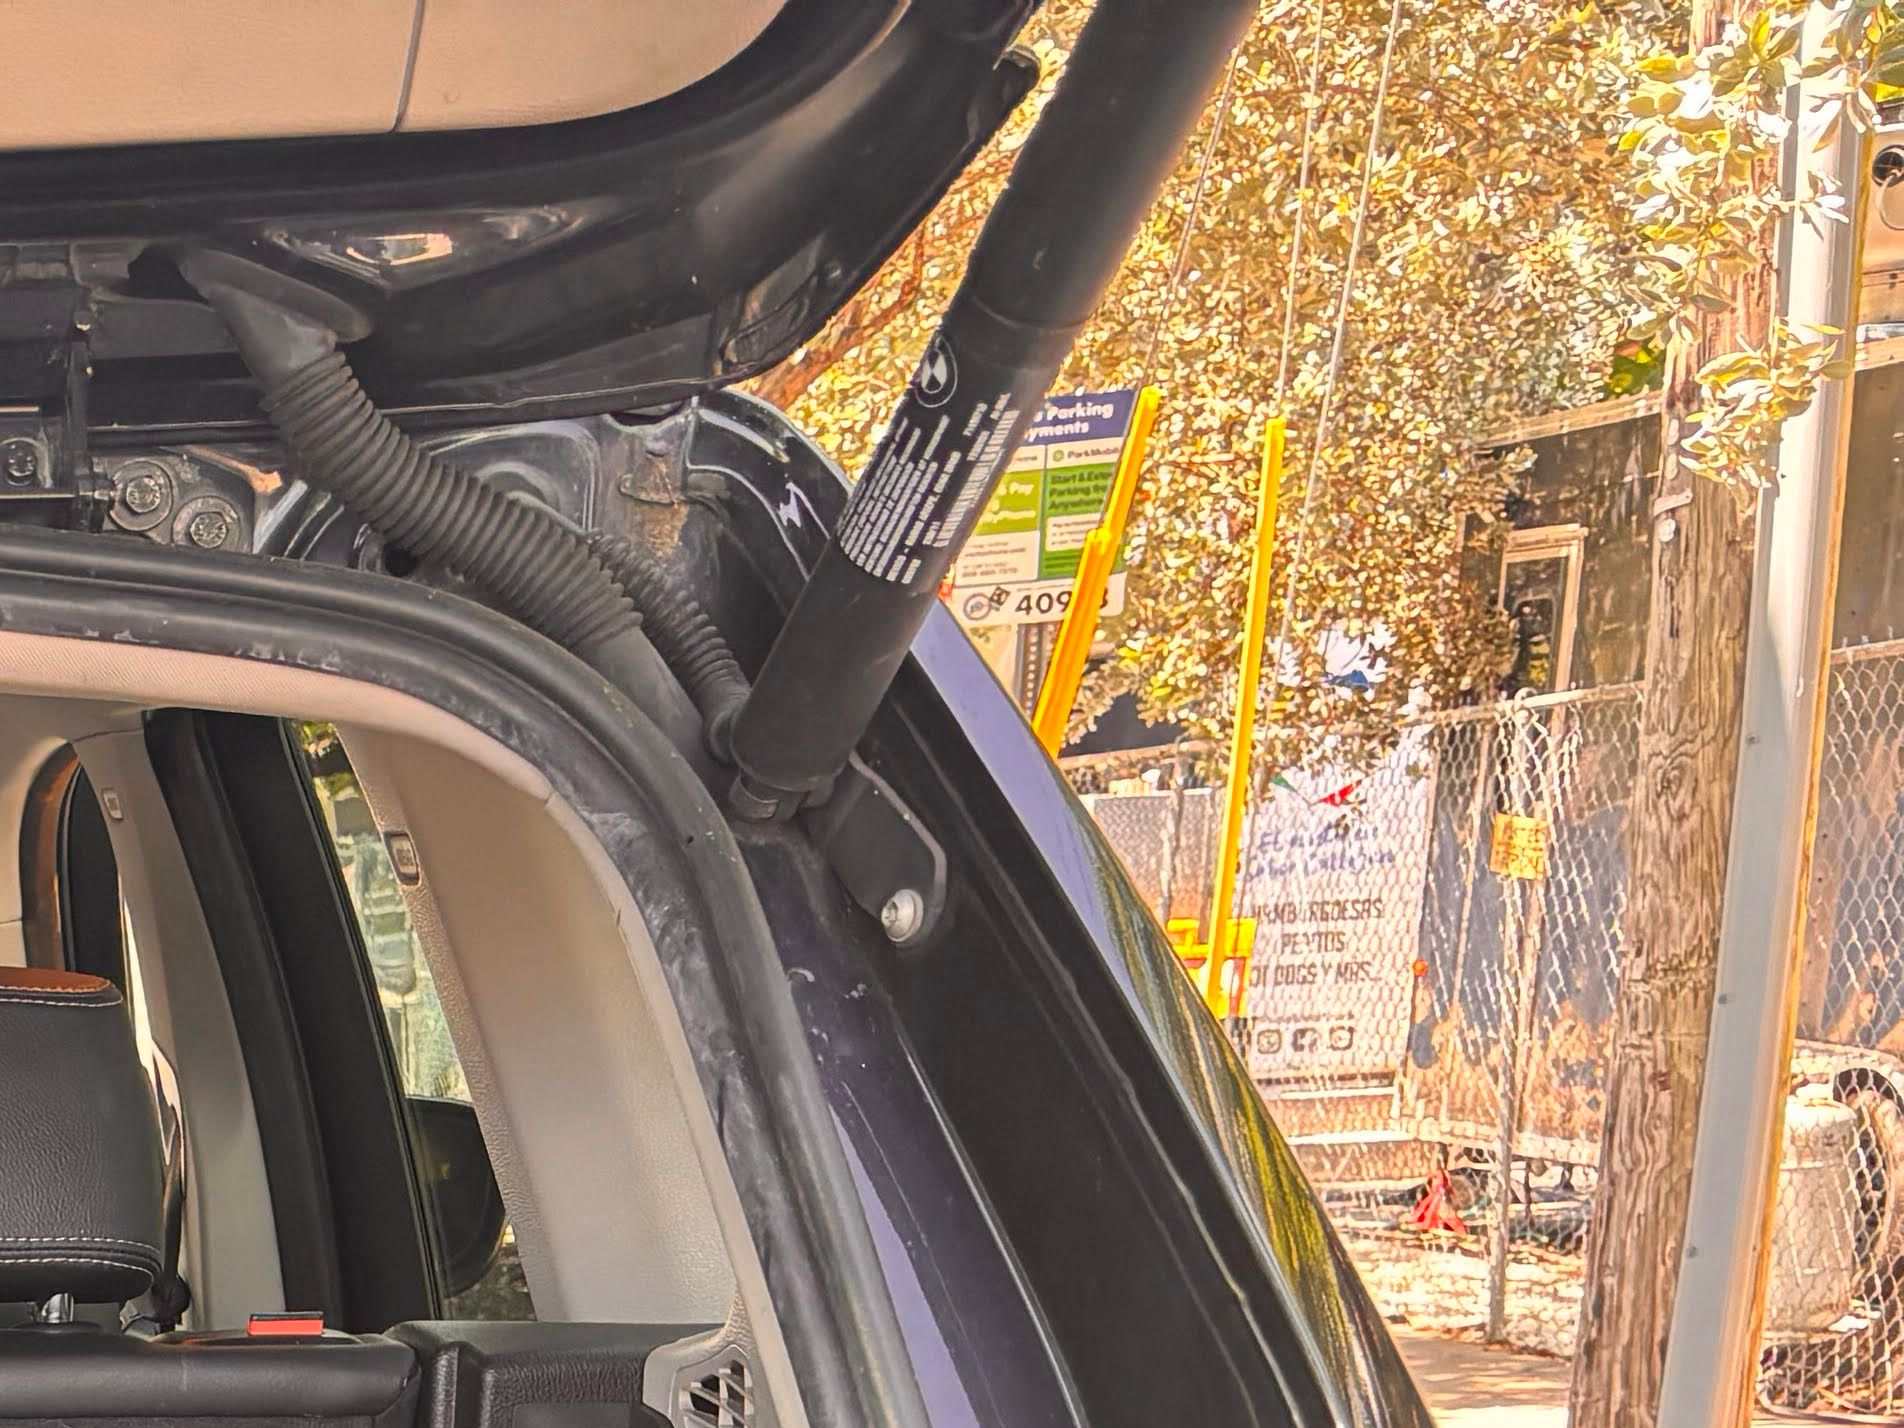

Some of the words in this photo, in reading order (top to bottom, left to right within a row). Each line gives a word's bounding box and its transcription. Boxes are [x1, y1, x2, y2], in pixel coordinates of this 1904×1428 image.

[1046, 402, 1114, 421] Parking
[1024, 421, 1089, 442] yments
[1067, 447, 1120, 459] ParkMobil
[1009, 481, 1035, 496] Pay
[1049, 486, 1091, 498] Parking
